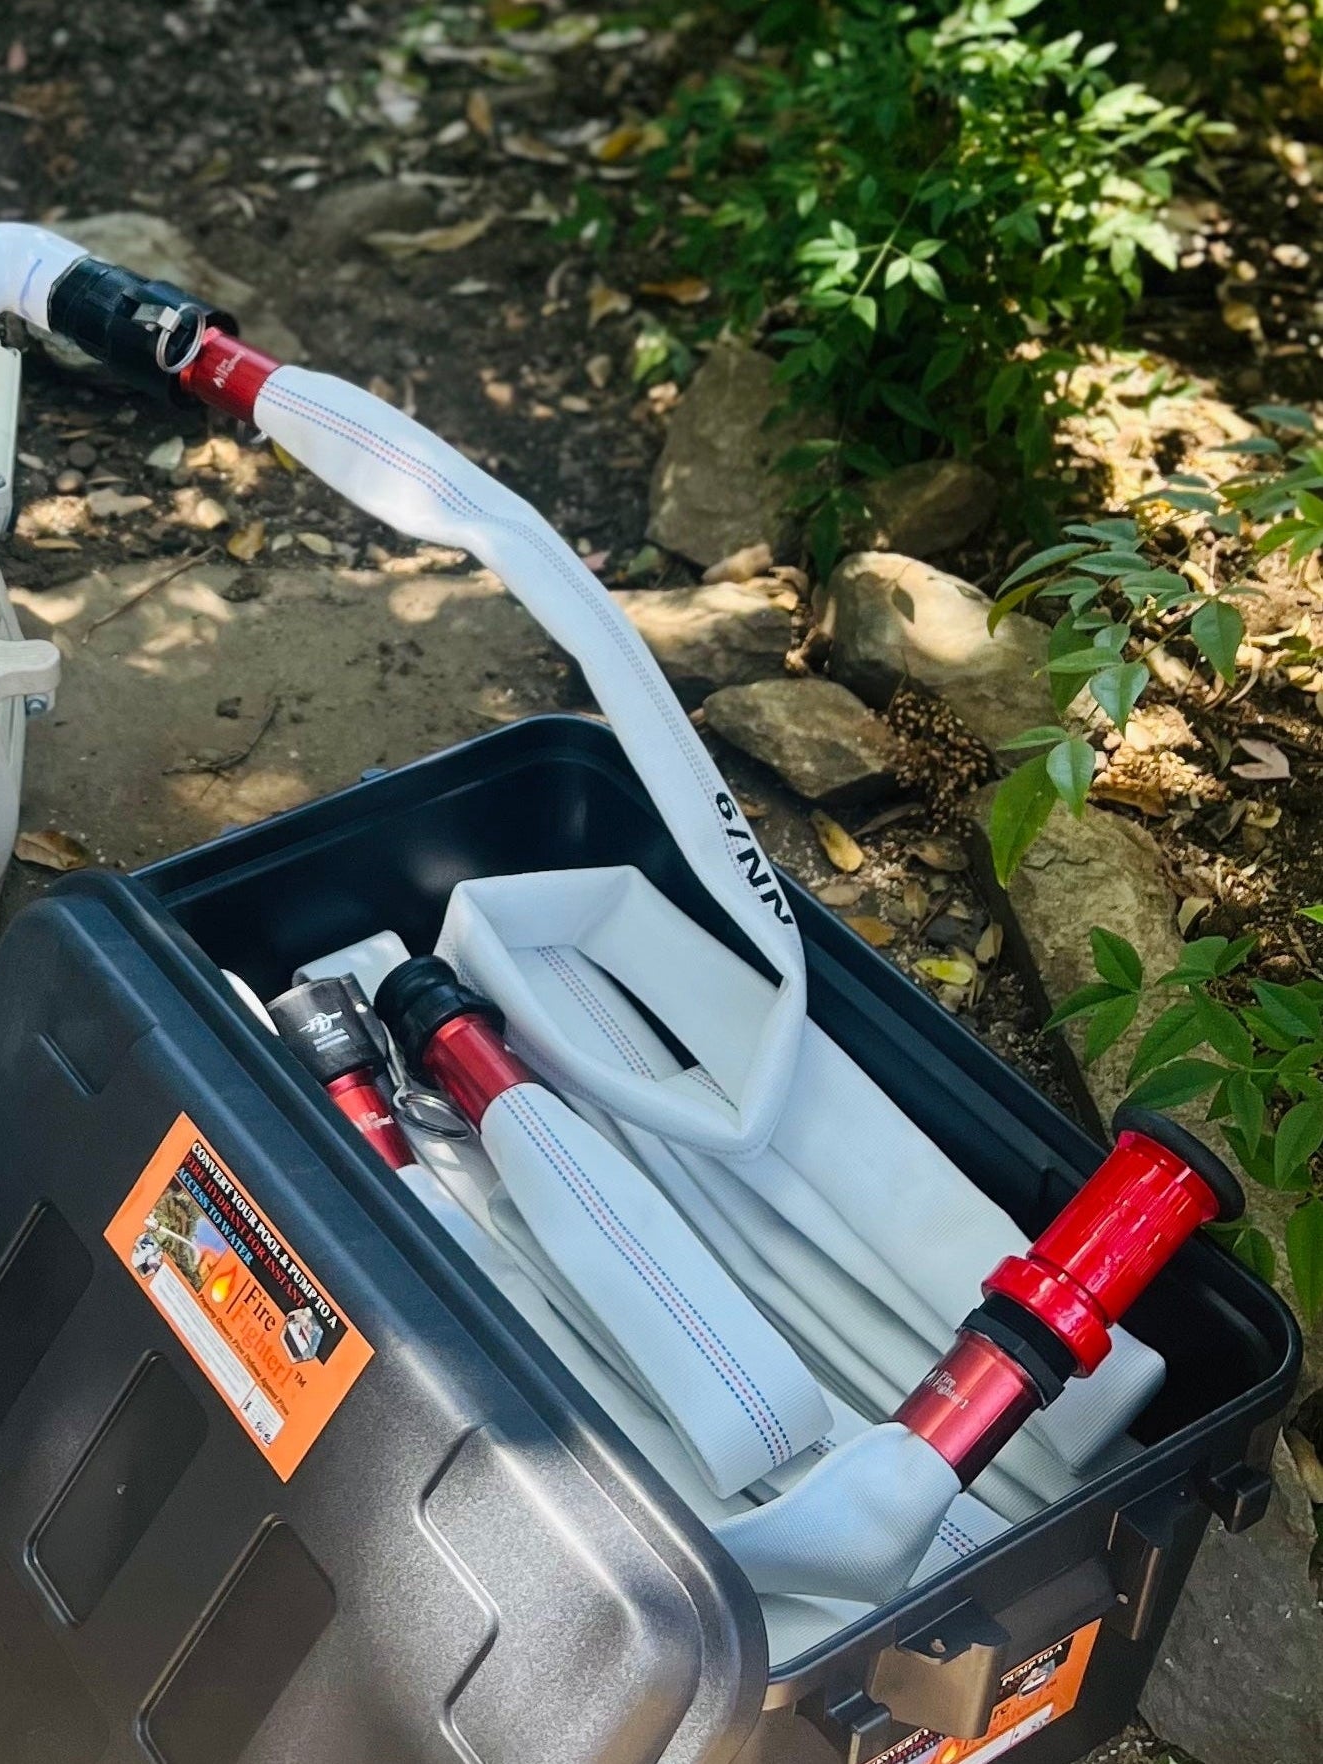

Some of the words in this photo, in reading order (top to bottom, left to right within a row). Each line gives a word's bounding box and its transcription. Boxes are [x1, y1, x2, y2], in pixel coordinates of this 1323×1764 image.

[177, 1166, 210, 1210] ACCESS
[205, 1202, 222, 1226] TO
[218, 1219, 254, 1266] WATER
[184, 1153, 205, 1182] FIRE
[203, 1178, 247, 1235] HYDRANT
[245, 1231, 266, 1260] FOR
[263, 1254, 304, 1308] INSTANT
[191, 1140, 232, 1196] CONVERT
[228, 1187, 258, 1228] YOUR
[256, 1222, 283, 1259] POOL
[280, 1252, 291, 1269] &
[287, 1261, 317, 1301] PUMP
[312, 1293, 330, 1318] TO
[327, 1313, 339, 1330] A
[242, 1284, 276, 1333] Fire
